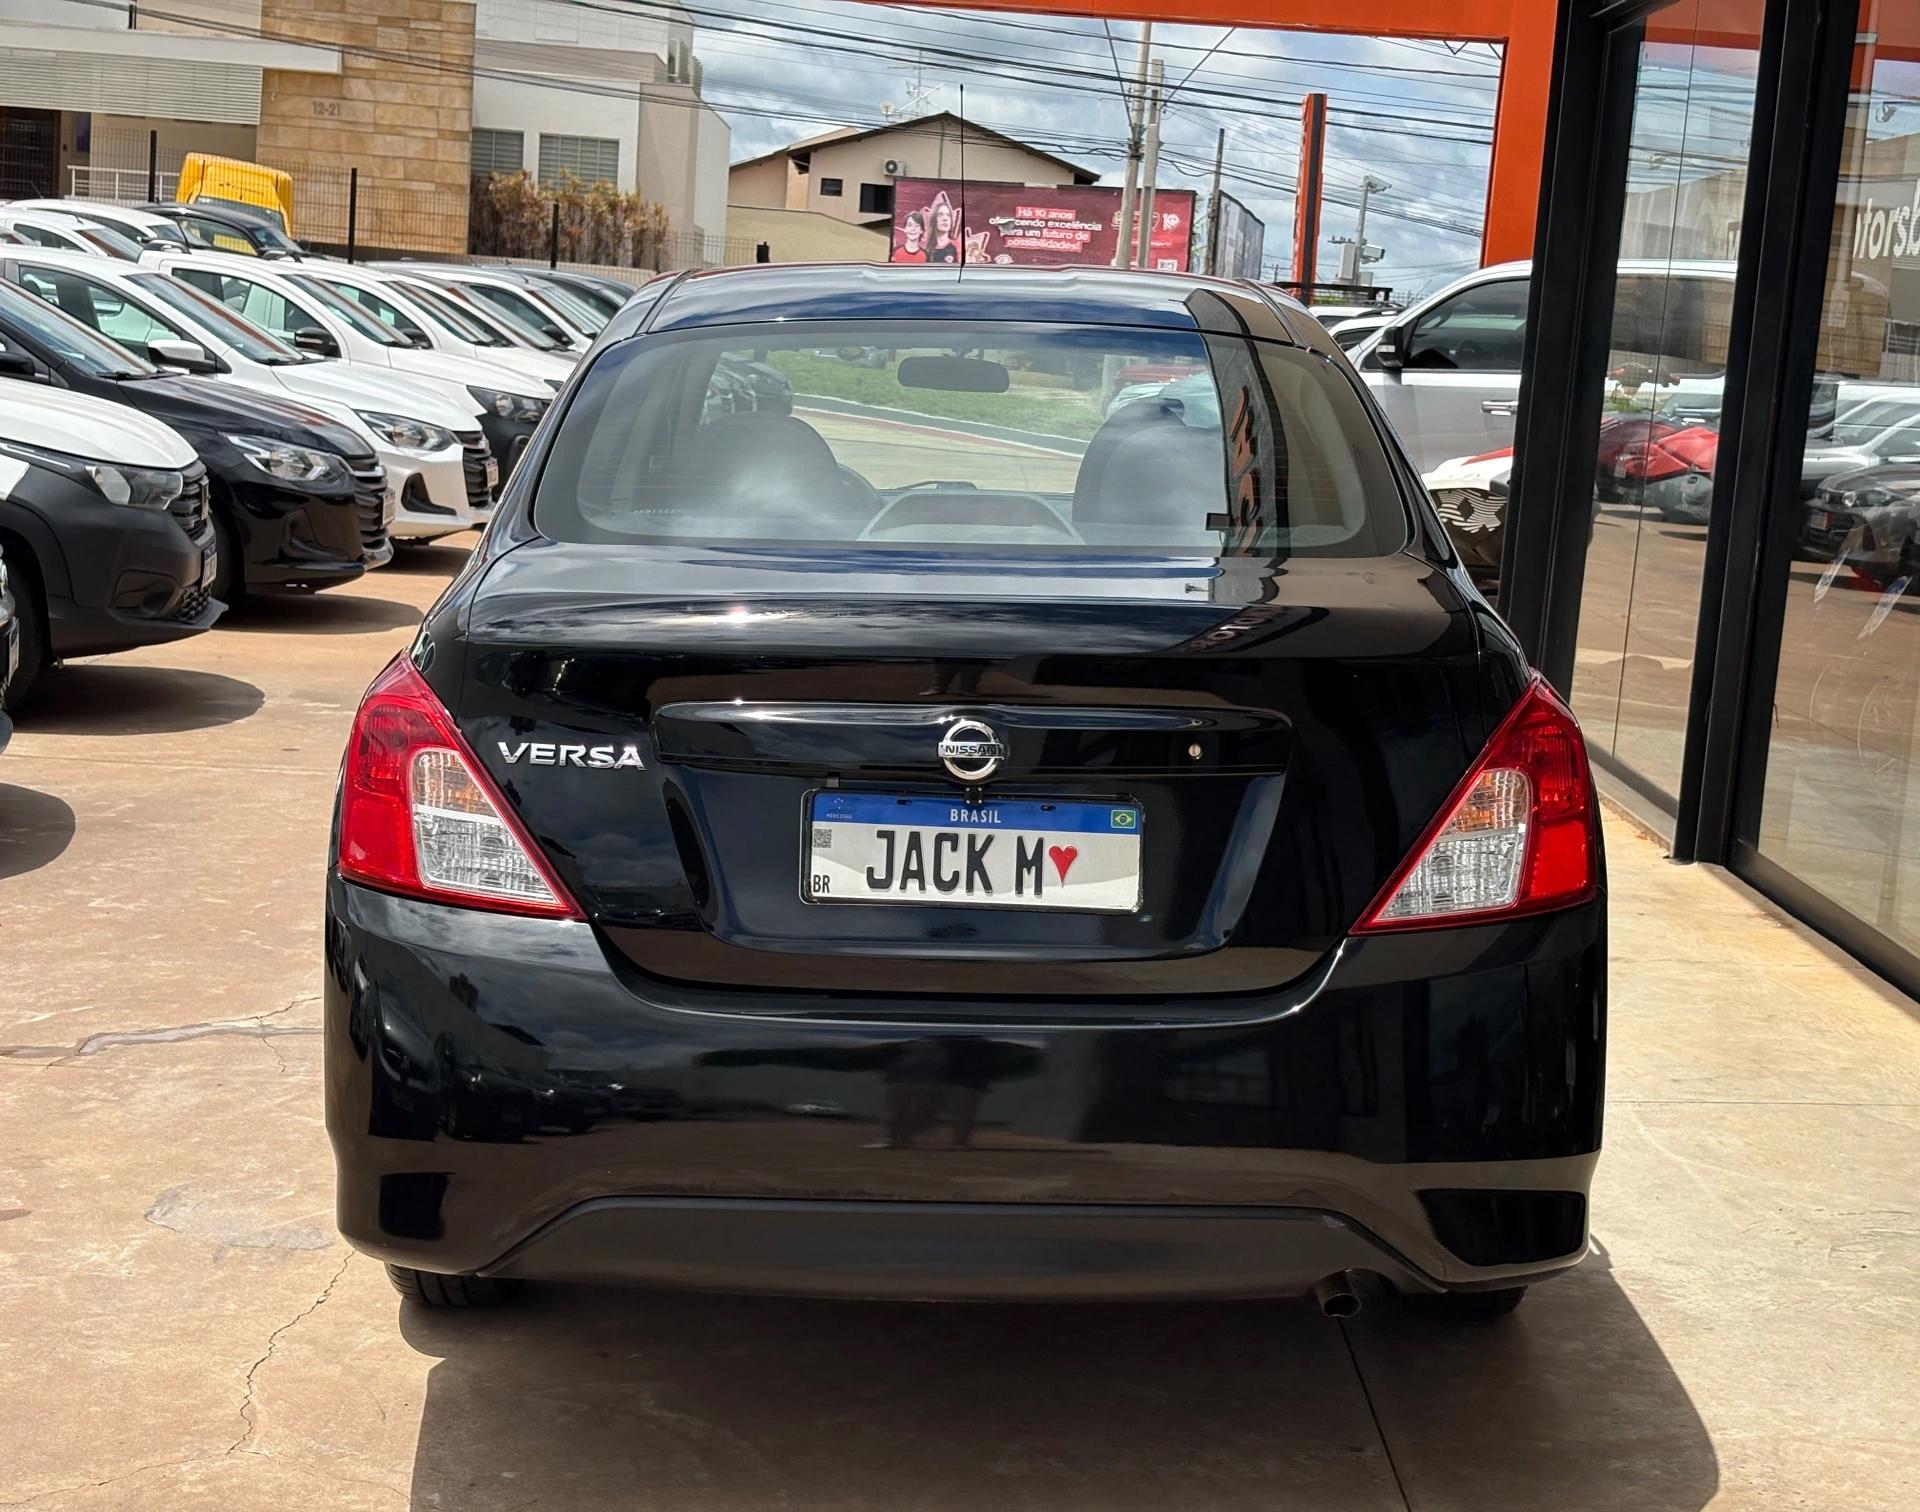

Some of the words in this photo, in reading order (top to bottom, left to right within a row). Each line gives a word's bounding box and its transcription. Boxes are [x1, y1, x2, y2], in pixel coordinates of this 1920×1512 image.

[1018, 208, 1032, 217] Há
[1035, 209, 1047, 218] 10
[1048, 211, 1073, 219] anos
[1047, 220, 1103, 231] excelência
[1042, 229, 1073, 239] futuro
[1075, 232, 1089, 241] de
[498, 741, 647, 771] VERSA
[945, 745, 997, 756] NISSAN
[950, 808, 1002, 824] BRASIL
[866, 829, 994, 894] JACK
[1014, 835, 1044, 896] M
[812, 874, 831, 894] BR
